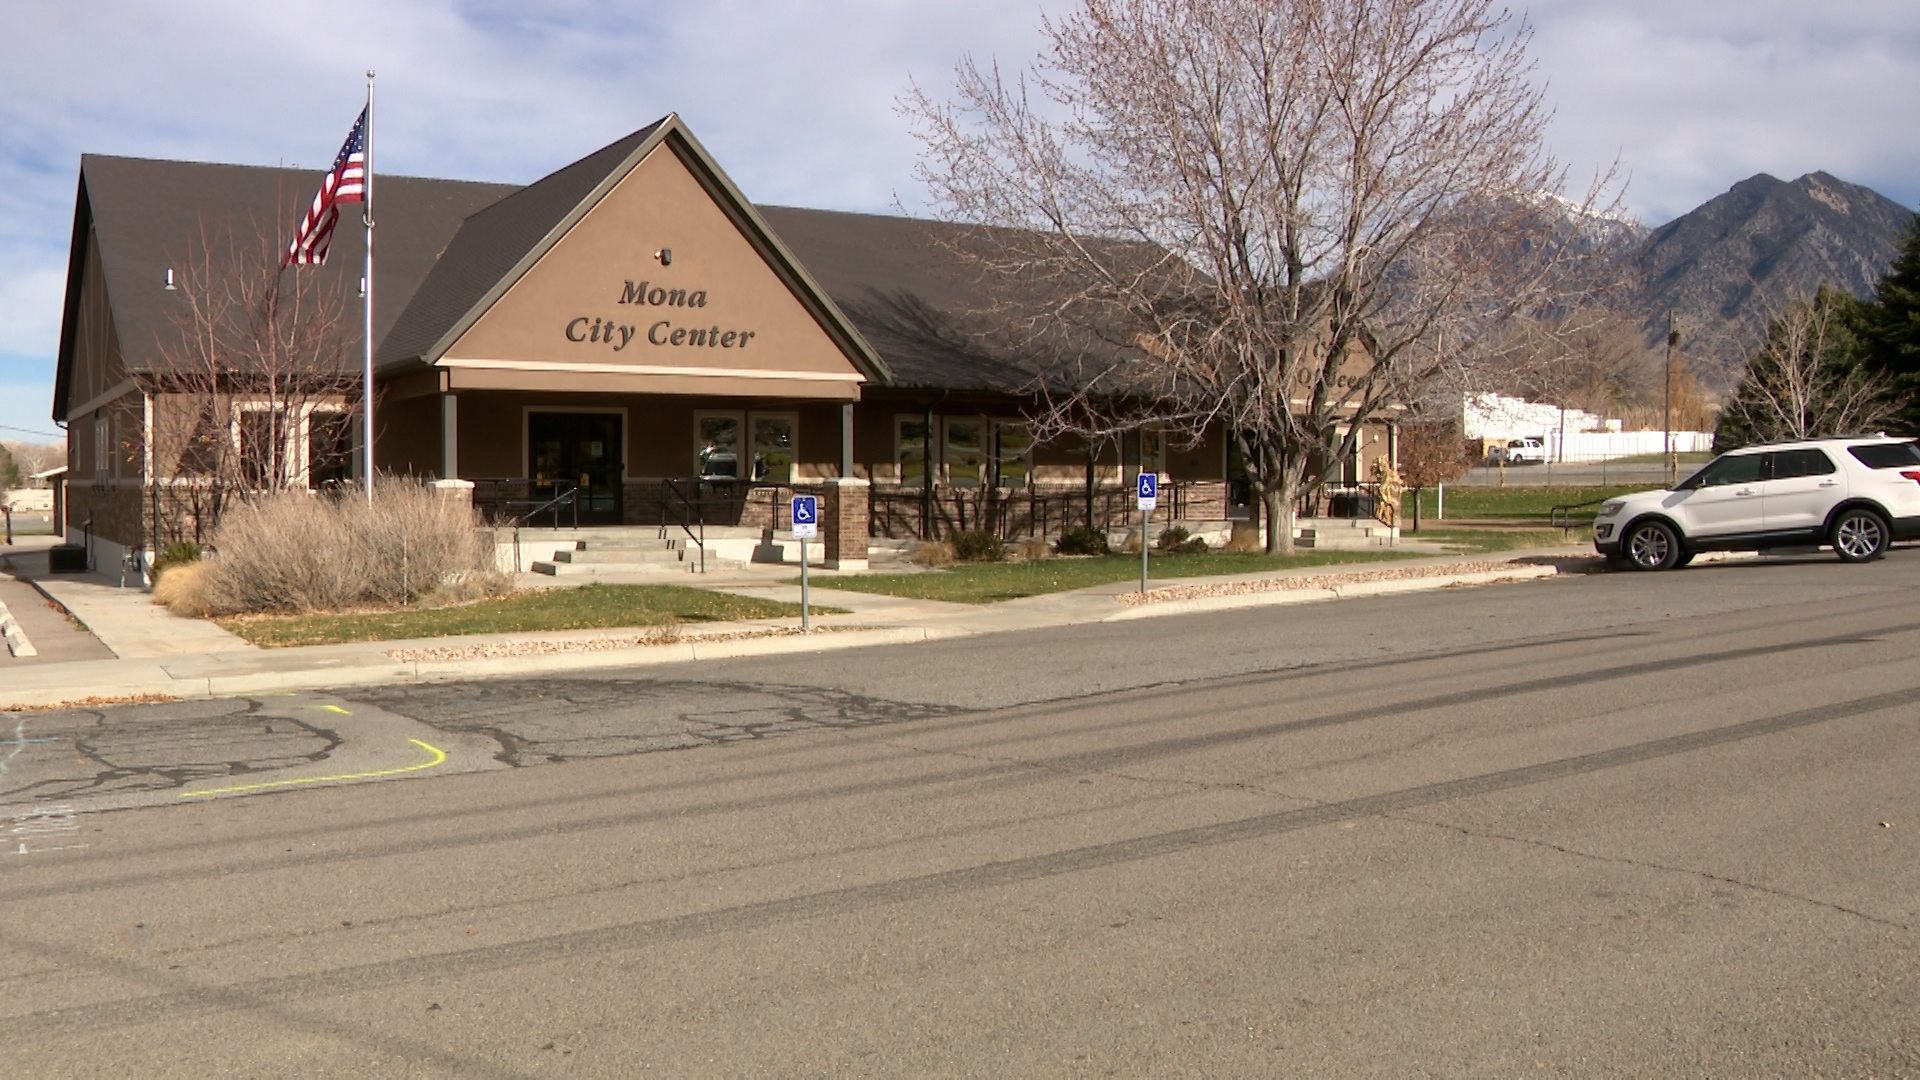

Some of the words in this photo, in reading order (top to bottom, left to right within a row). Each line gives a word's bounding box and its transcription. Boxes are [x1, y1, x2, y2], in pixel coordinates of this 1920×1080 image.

[618, 279, 708, 308] Mona
[565, 316, 636, 352] City
[647, 321, 756, 349] Center
